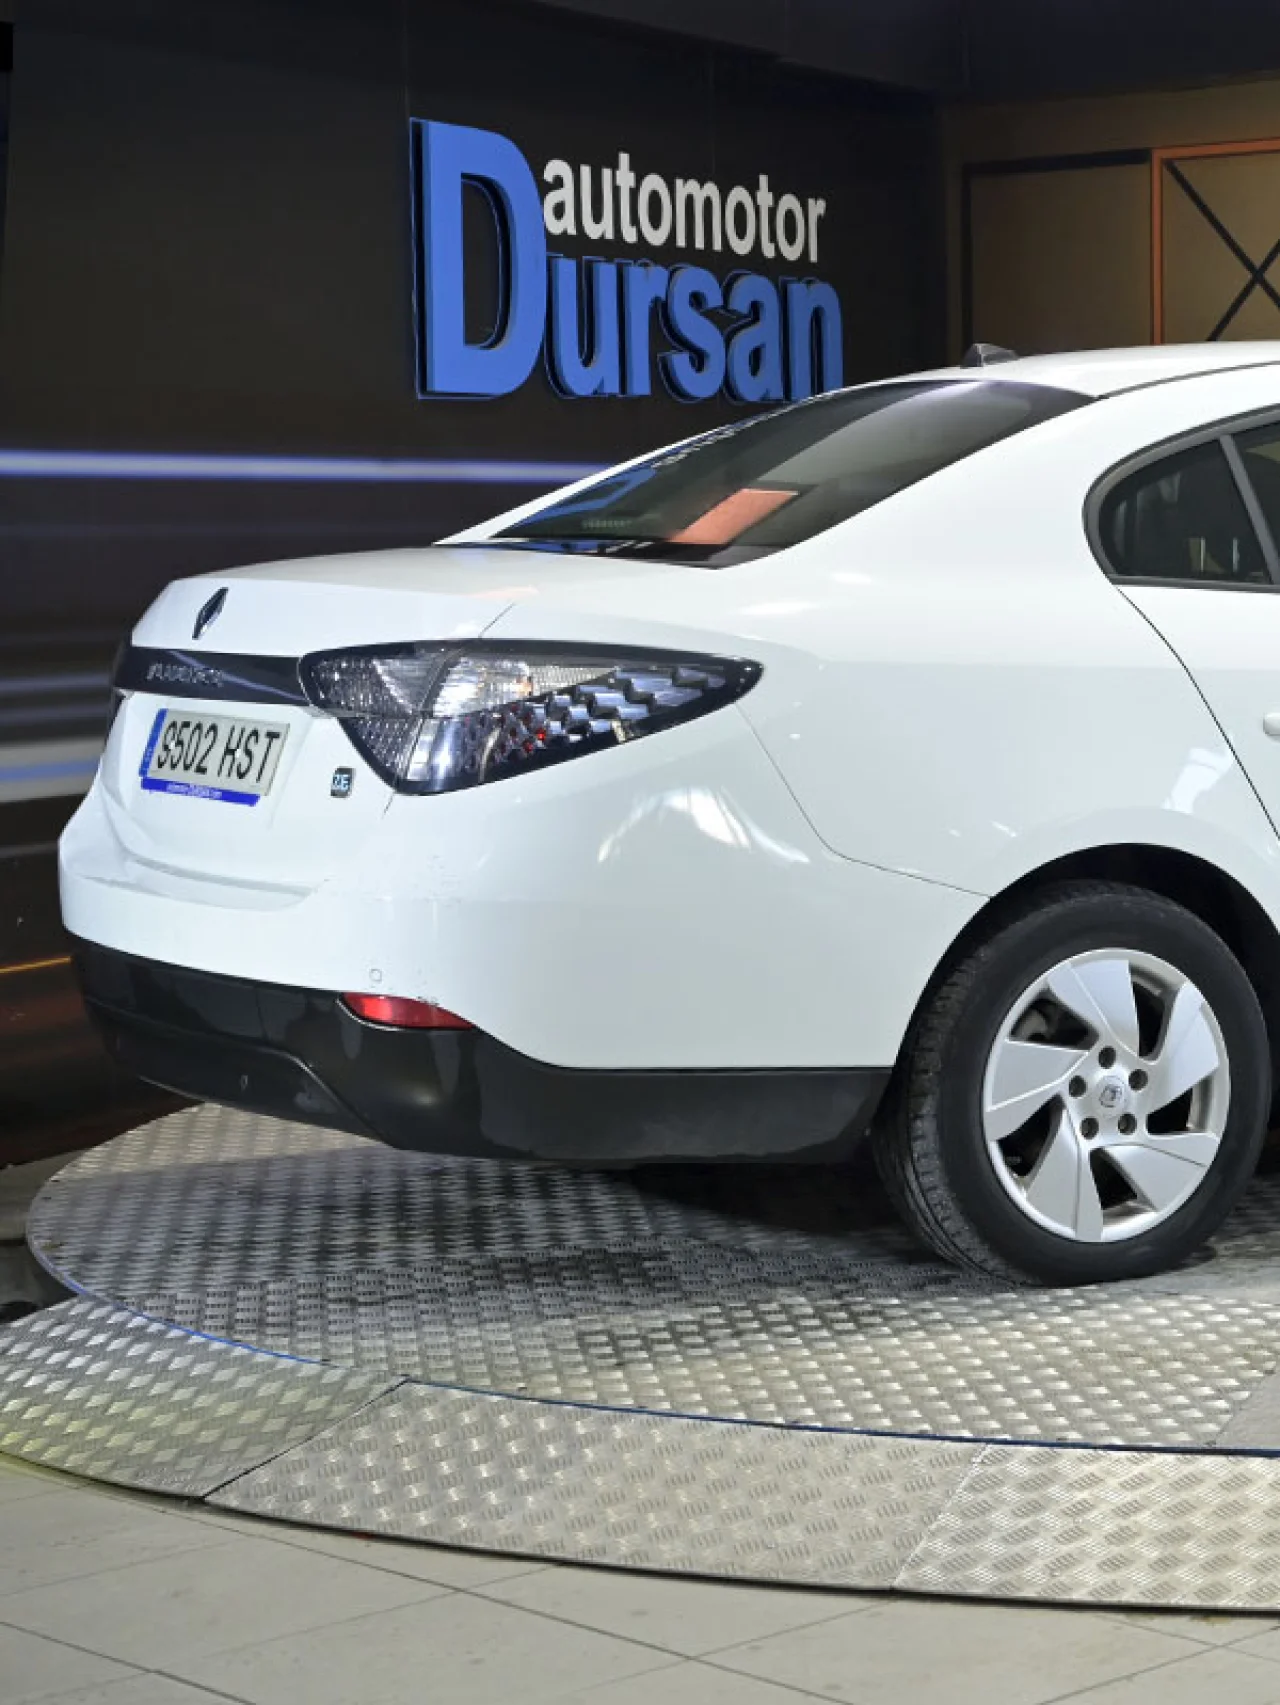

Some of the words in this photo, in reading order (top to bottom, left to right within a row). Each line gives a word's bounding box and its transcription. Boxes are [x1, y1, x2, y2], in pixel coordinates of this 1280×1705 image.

[410, 117, 843, 403] Dursan
[543, 152, 826, 262] automotor
[218, 725, 280, 783] HST
